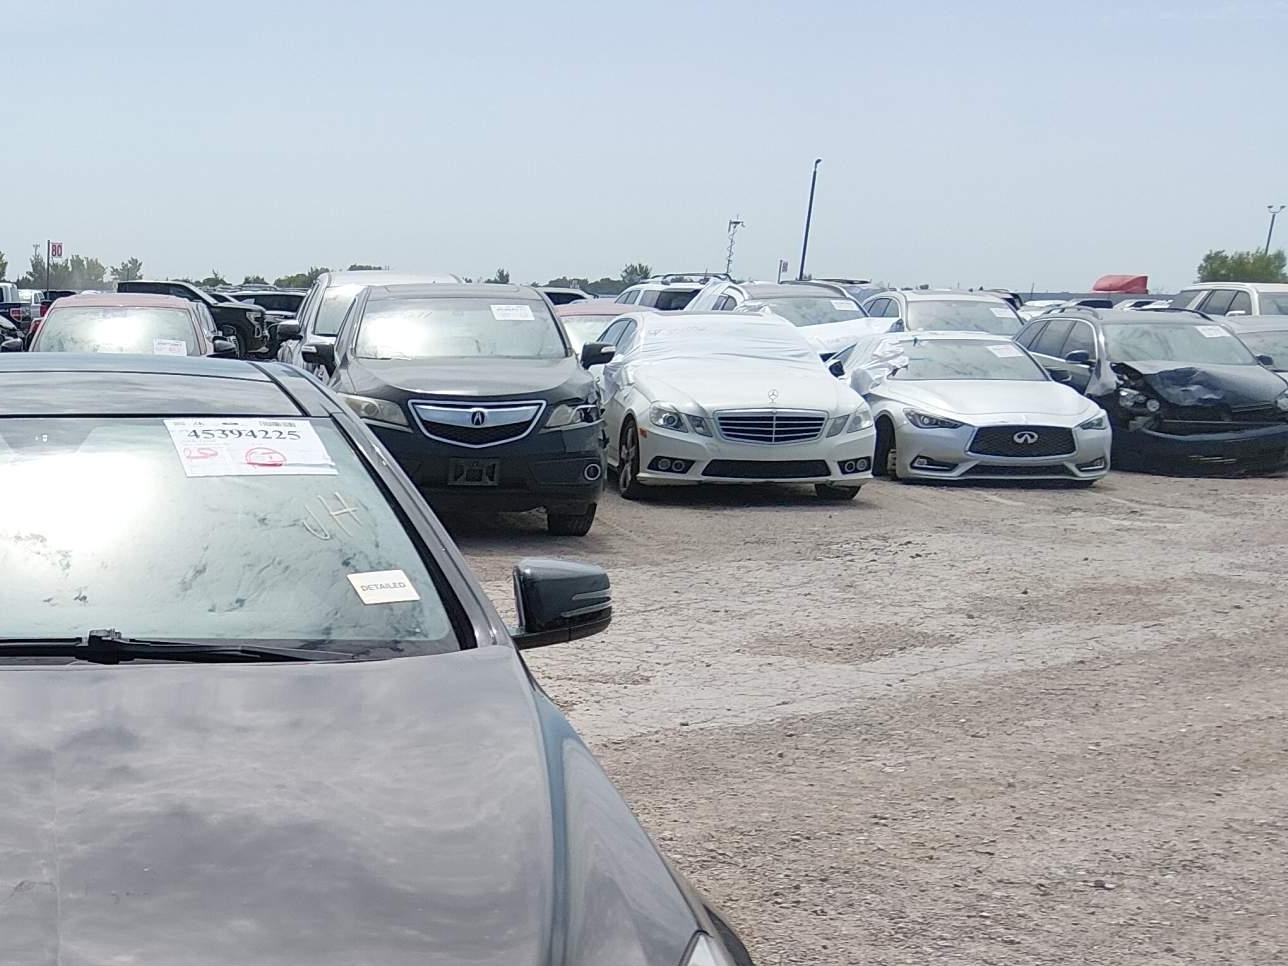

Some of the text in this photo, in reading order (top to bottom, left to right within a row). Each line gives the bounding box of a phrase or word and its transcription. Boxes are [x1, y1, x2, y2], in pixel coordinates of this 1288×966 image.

[51, 244, 63, 257] 80
[187, 429, 302, 440] 45394225
[360, 581, 407, 592] DETAILED
